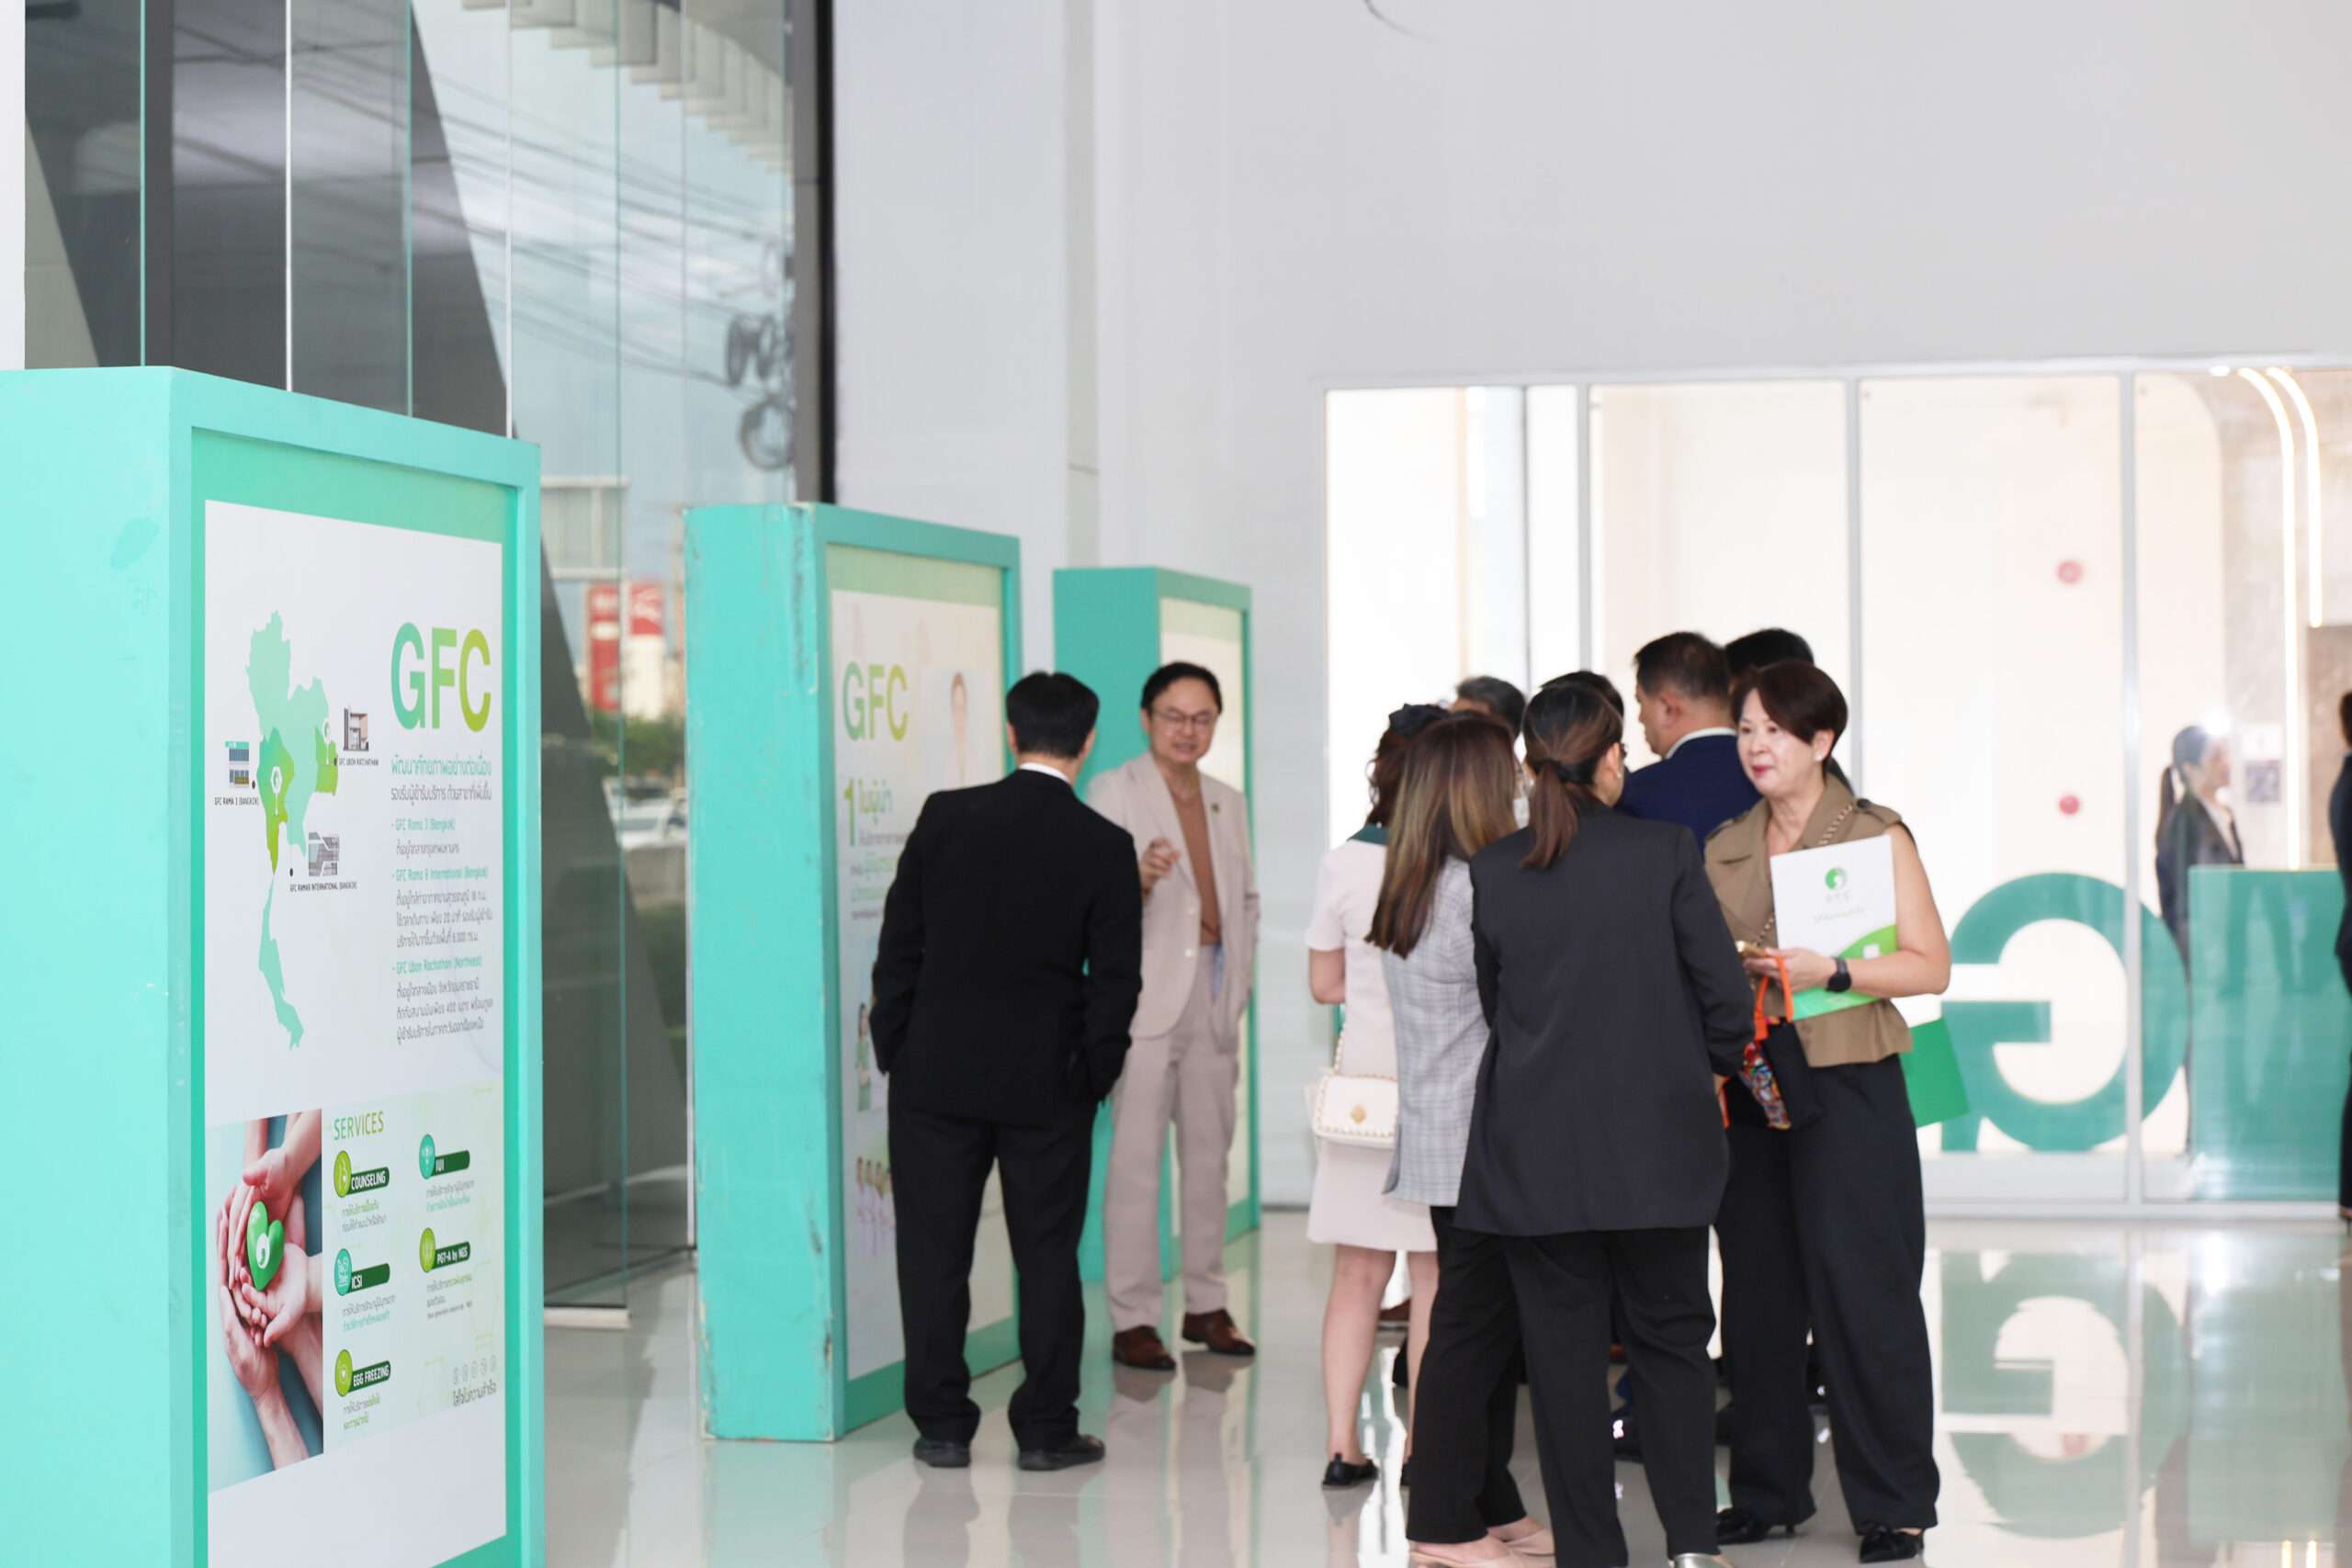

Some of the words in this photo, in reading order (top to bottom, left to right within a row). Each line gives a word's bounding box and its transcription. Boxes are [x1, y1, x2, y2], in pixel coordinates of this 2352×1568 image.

[391, 622, 491, 732] GFC
[842, 661, 908, 741] GFC
[334, 1110, 384, 1140] SERVICES
[351, 1170, 386, 1190] COUNSELING
[351, 1273, 363, 1289] ICSI
[353, 1371, 364, 1387] EGG
[365, 1364, 390, 1383] FREEZING
